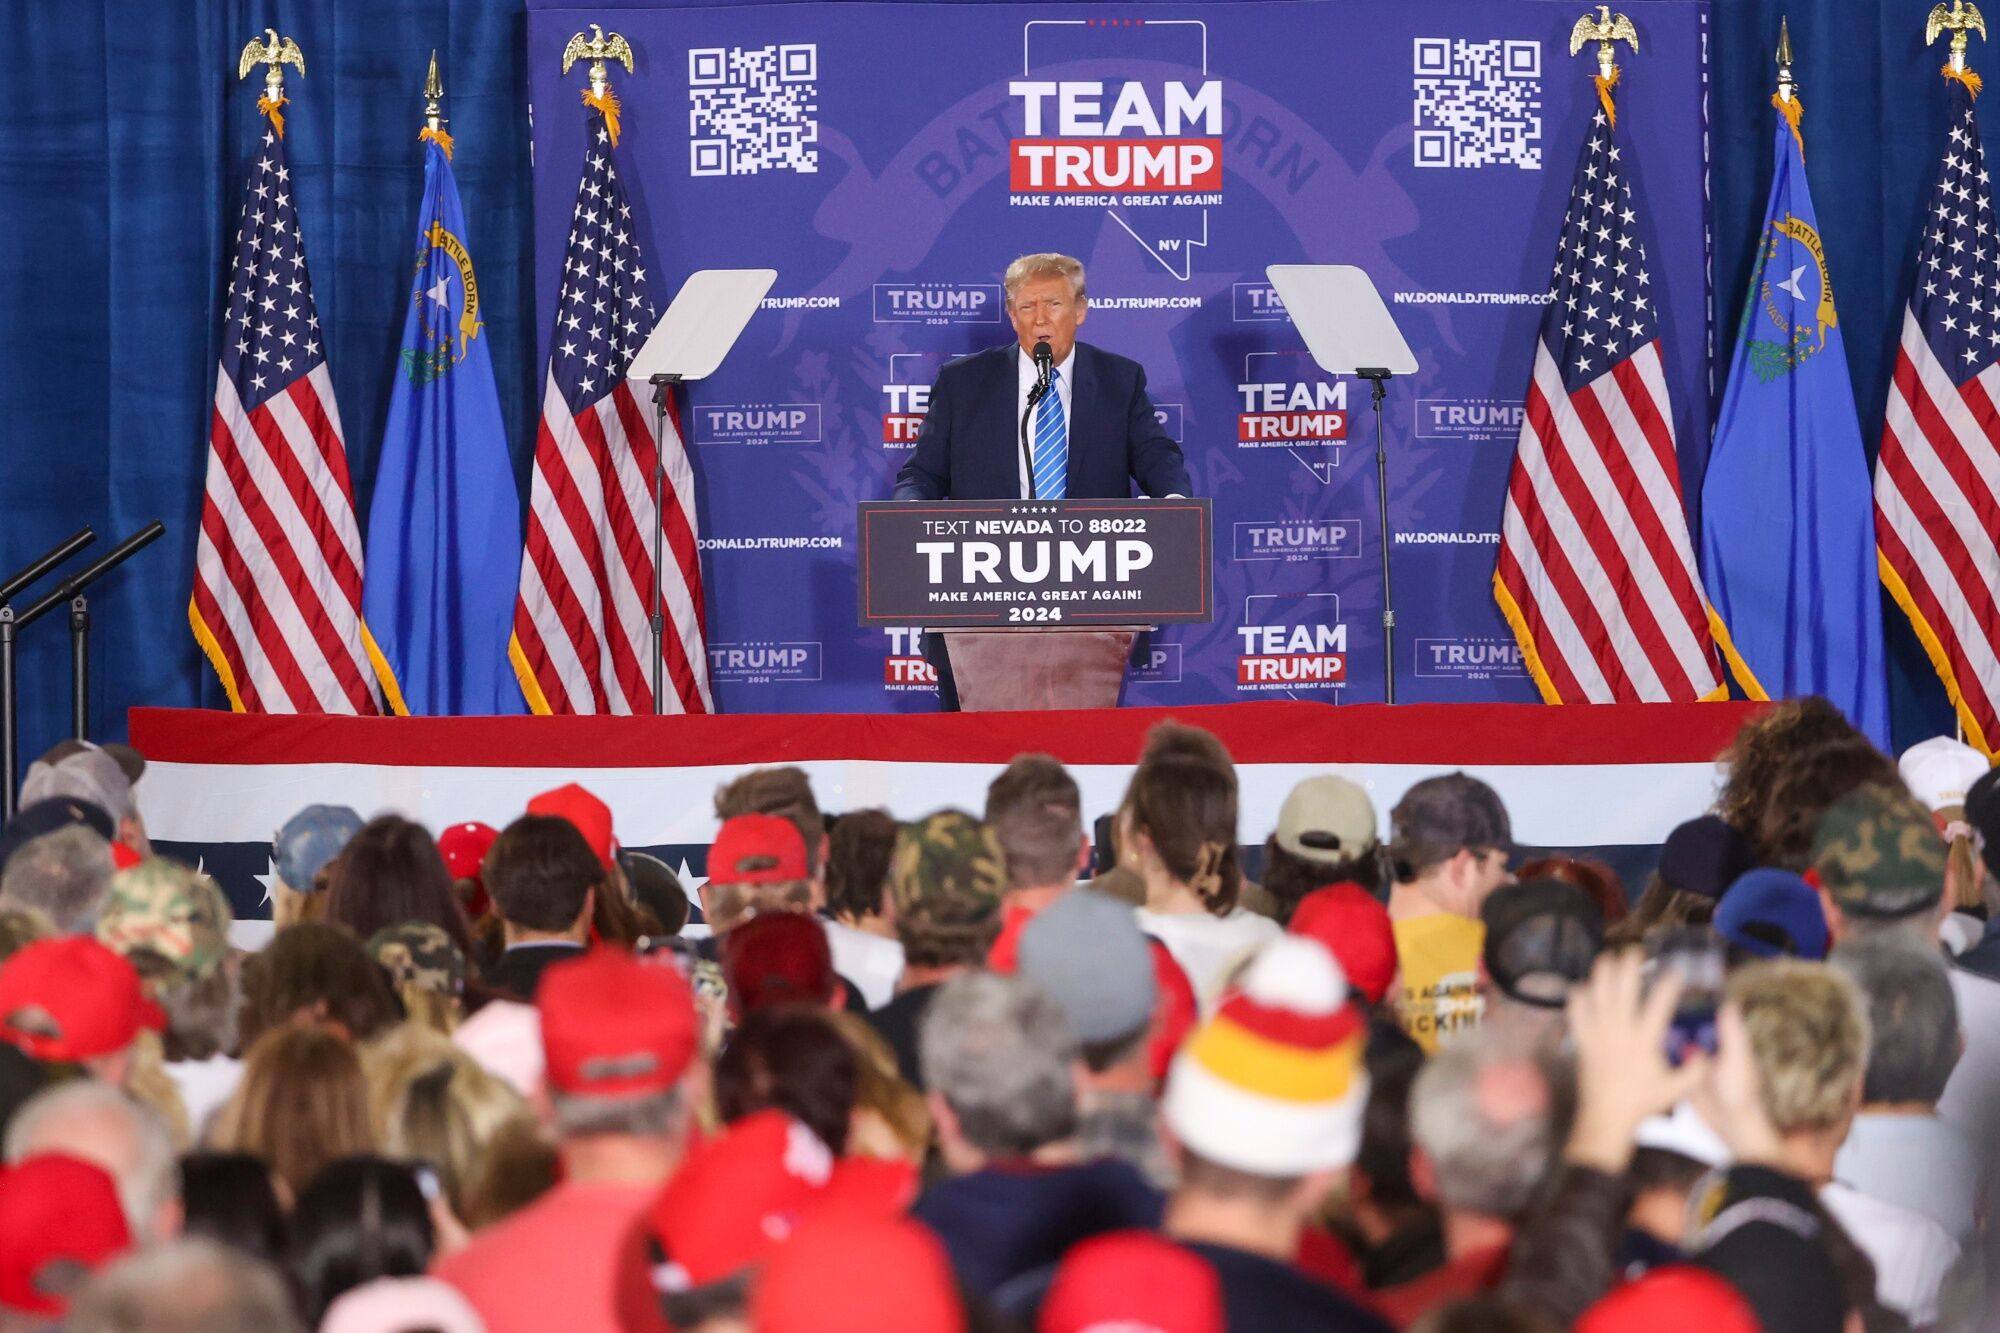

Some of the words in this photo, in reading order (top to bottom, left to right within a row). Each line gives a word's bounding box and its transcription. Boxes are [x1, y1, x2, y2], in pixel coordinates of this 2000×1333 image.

[1009, 80, 1222, 136] TEAM
[914, 101, 1012, 198] BAT
[1018, 145, 1214, 187] TRUMP
[1010, 196, 1050, 206] MAKE
[1054, 195, 1118, 206] AMERICA
[1122, 195, 1169, 206] GREAT
[1173, 194, 1222, 205] AGAIN!
[1158, 240, 1181, 251] NV
[464, 270, 477, 314] BORN
[888, 291, 986, 309] TRUMP
[1394, 292, 1551, 305] NV.DONALDJTRUMP.CO
[1087, 297, 1201, 309] ALDJTRUMP.COM
[883, 385, 931, 413] TE
[1238, 382, 1347, 412] TEAM
[708, 411, 806, 430] TRUMP
[1430, 406, 1524, 425] TRUMP
[1242, 415, 1342, 438] TRUMP
[923, 520, 970, 535] TEXT
[976, 519, 1053, 535] NEVADA
[1059, 519, 1083, 534] TO
[1089, 518, 1146, 533] 88022
[1248, 526, 1346, 547] TRUMP
[698, 537, 842, 550] DONALDJTRUMP.COM
[1395, 533, 1501, 544] NV.DONALDJTR
[916, 540, 1153, 584] TRUMP
[928, 591, 968, 602] MAKE
[973, 591, 1037, 602] AMERICA
[1041, 590, 1087, 601] GREAT
[1092, 590, 1142, 600] AGAIN!
[1008, 607, 1062, 622] 2024
[884, 627, 923, 655] TE
[1238, 624, 1346, 655] TEAM
[710, 648, 808, 668] TRUMP
[889, 660, 938, 681] TRU
[1242, 657, 1342, 680] TRUMP
